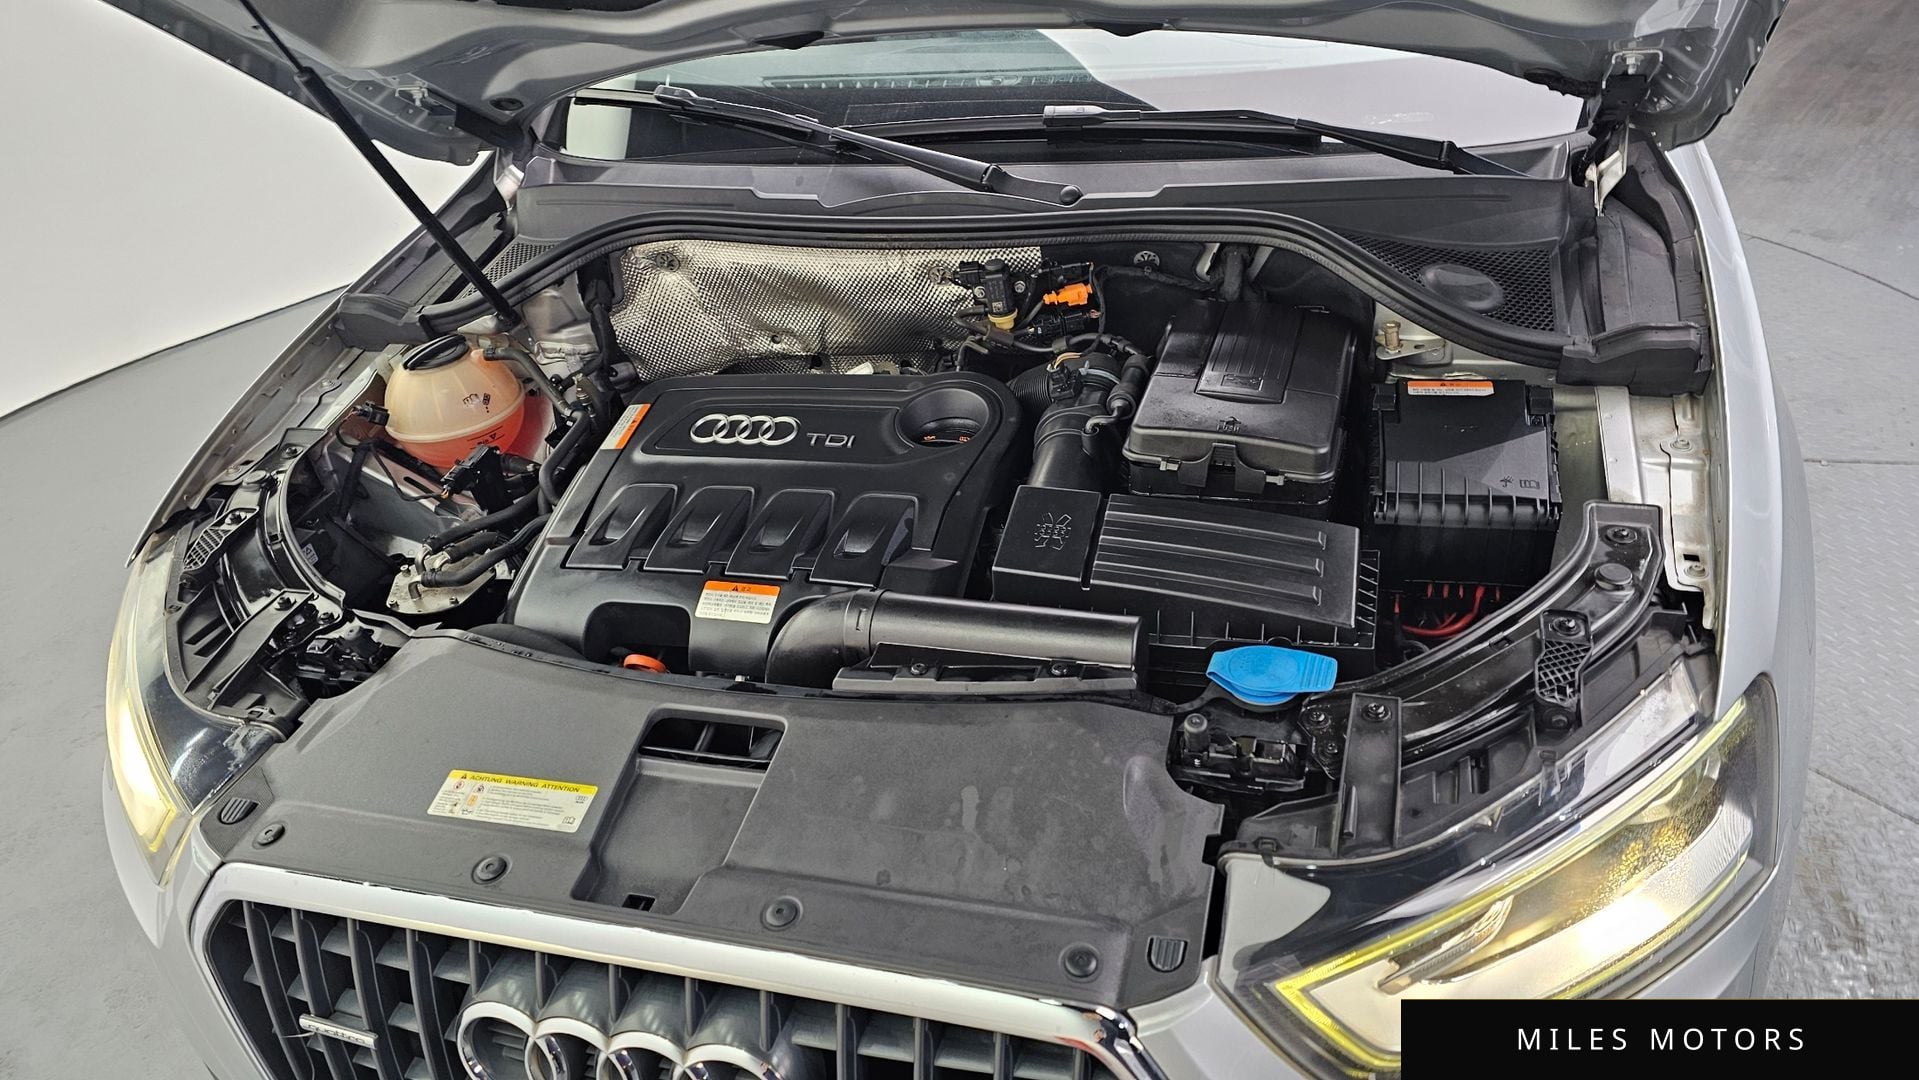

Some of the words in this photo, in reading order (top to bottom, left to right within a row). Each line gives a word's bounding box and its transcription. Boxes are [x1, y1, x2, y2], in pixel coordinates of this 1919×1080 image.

[806, 432, 856, 449] TDI
[469, 775, 503, 784] ACHTUNG
[505, 779, 539, 788] WARNING
[541, 783, 580, 793] ATTENTION
